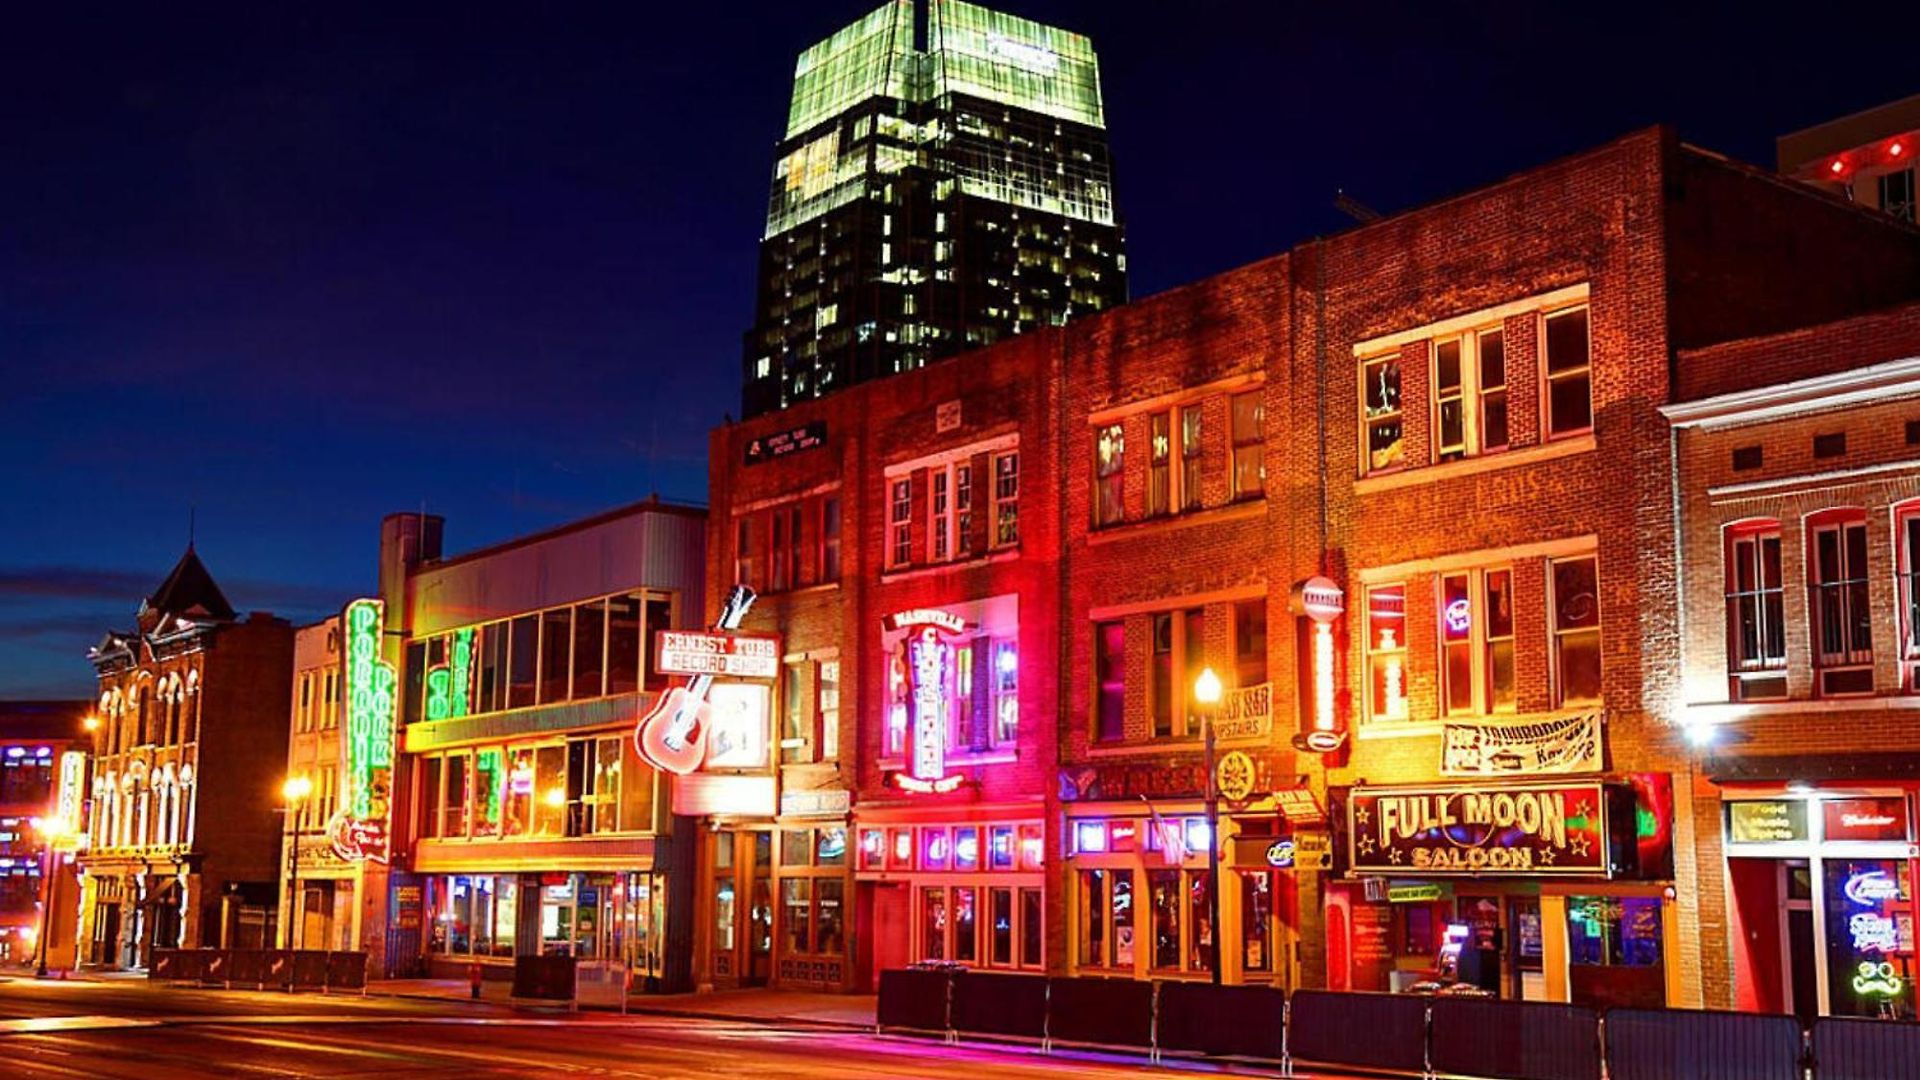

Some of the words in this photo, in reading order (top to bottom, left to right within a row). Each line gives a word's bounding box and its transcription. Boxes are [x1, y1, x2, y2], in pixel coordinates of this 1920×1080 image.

[663, 632, 727, 653] ERNEST
[733, 639, 776, 656] TUBB
[670, 653, 727, 672] RECORD
[731, 658, 769, 673] SHOP
[353, 606, 376, 819] PARADISE
[372, 666, 392, 766] PARK
[1378, 794, 1456, 849] FULL
[1463, 792, 1566, 849] MOON
[1413, 847, 1532, 869] SALOON
